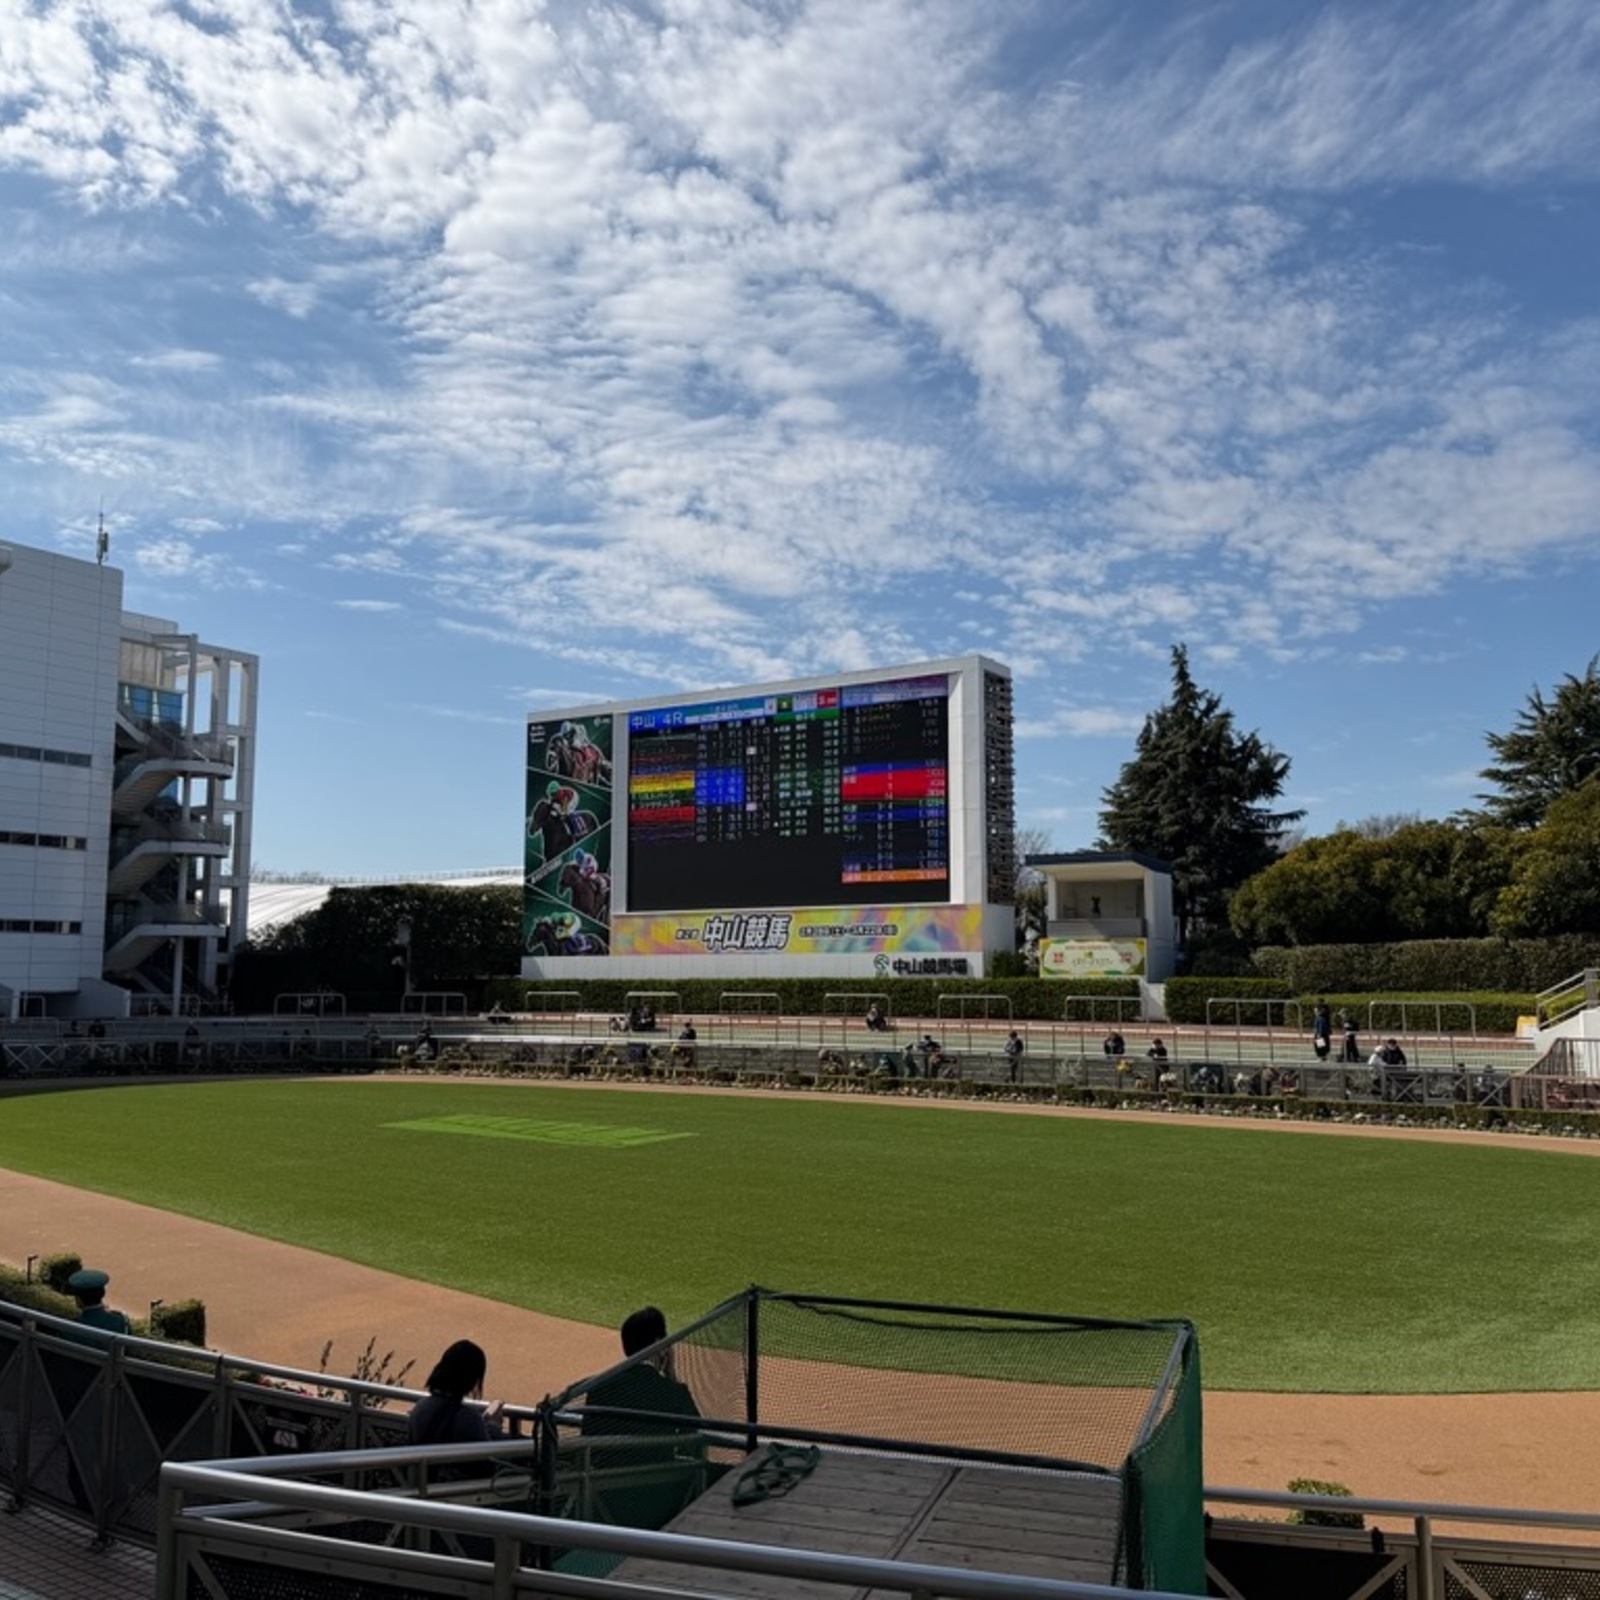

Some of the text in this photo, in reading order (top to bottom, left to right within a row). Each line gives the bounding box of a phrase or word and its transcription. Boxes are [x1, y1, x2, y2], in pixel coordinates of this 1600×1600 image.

[631, 714, 656, 729] 中山
[662, 711, 683, 725] 4R
[702, 914, 792, 950] 中山競馬
[892, 958, 968, 975] 中山競馬場
